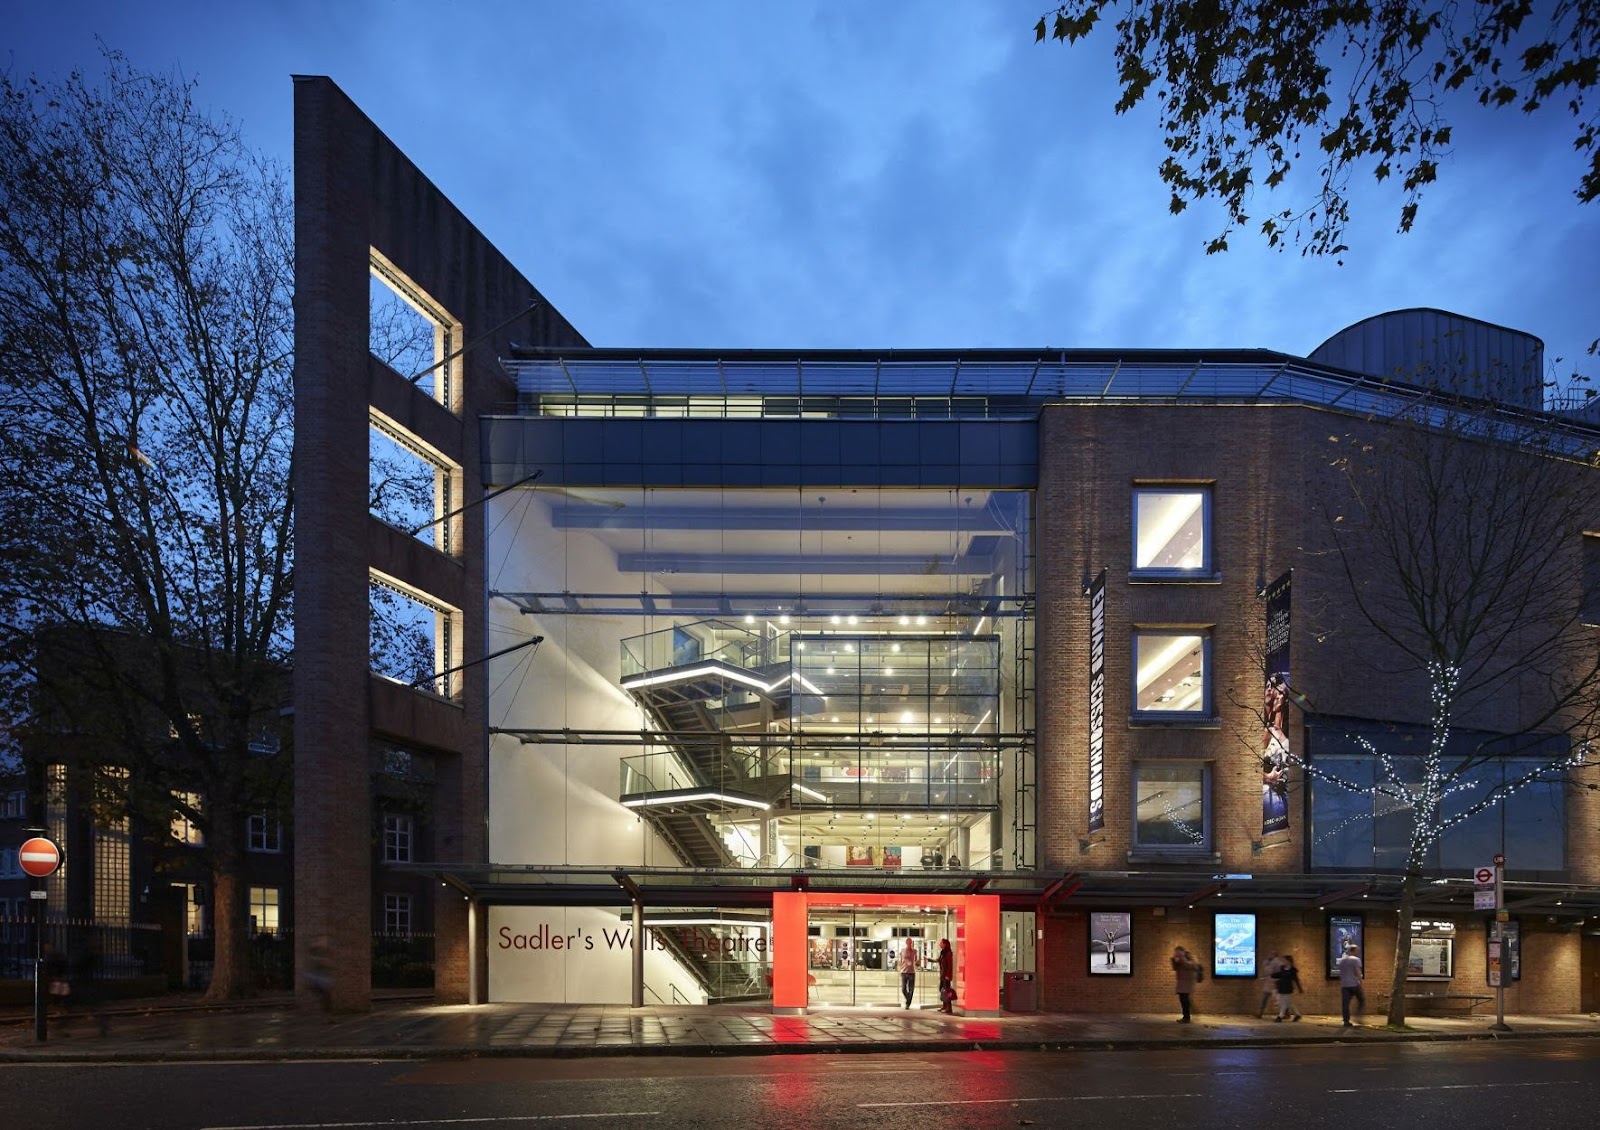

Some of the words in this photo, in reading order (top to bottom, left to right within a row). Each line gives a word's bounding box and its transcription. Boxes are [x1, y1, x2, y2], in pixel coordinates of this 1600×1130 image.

[1091, 586, 1105, 675] EDWARD
[1090, 673, 1104, 813] SCISSORHANDS
[498, 924, 594, 950] Sadler's
[602, 926, 666, 952] Wlls
[680, 926, 767, 952] Theatre
